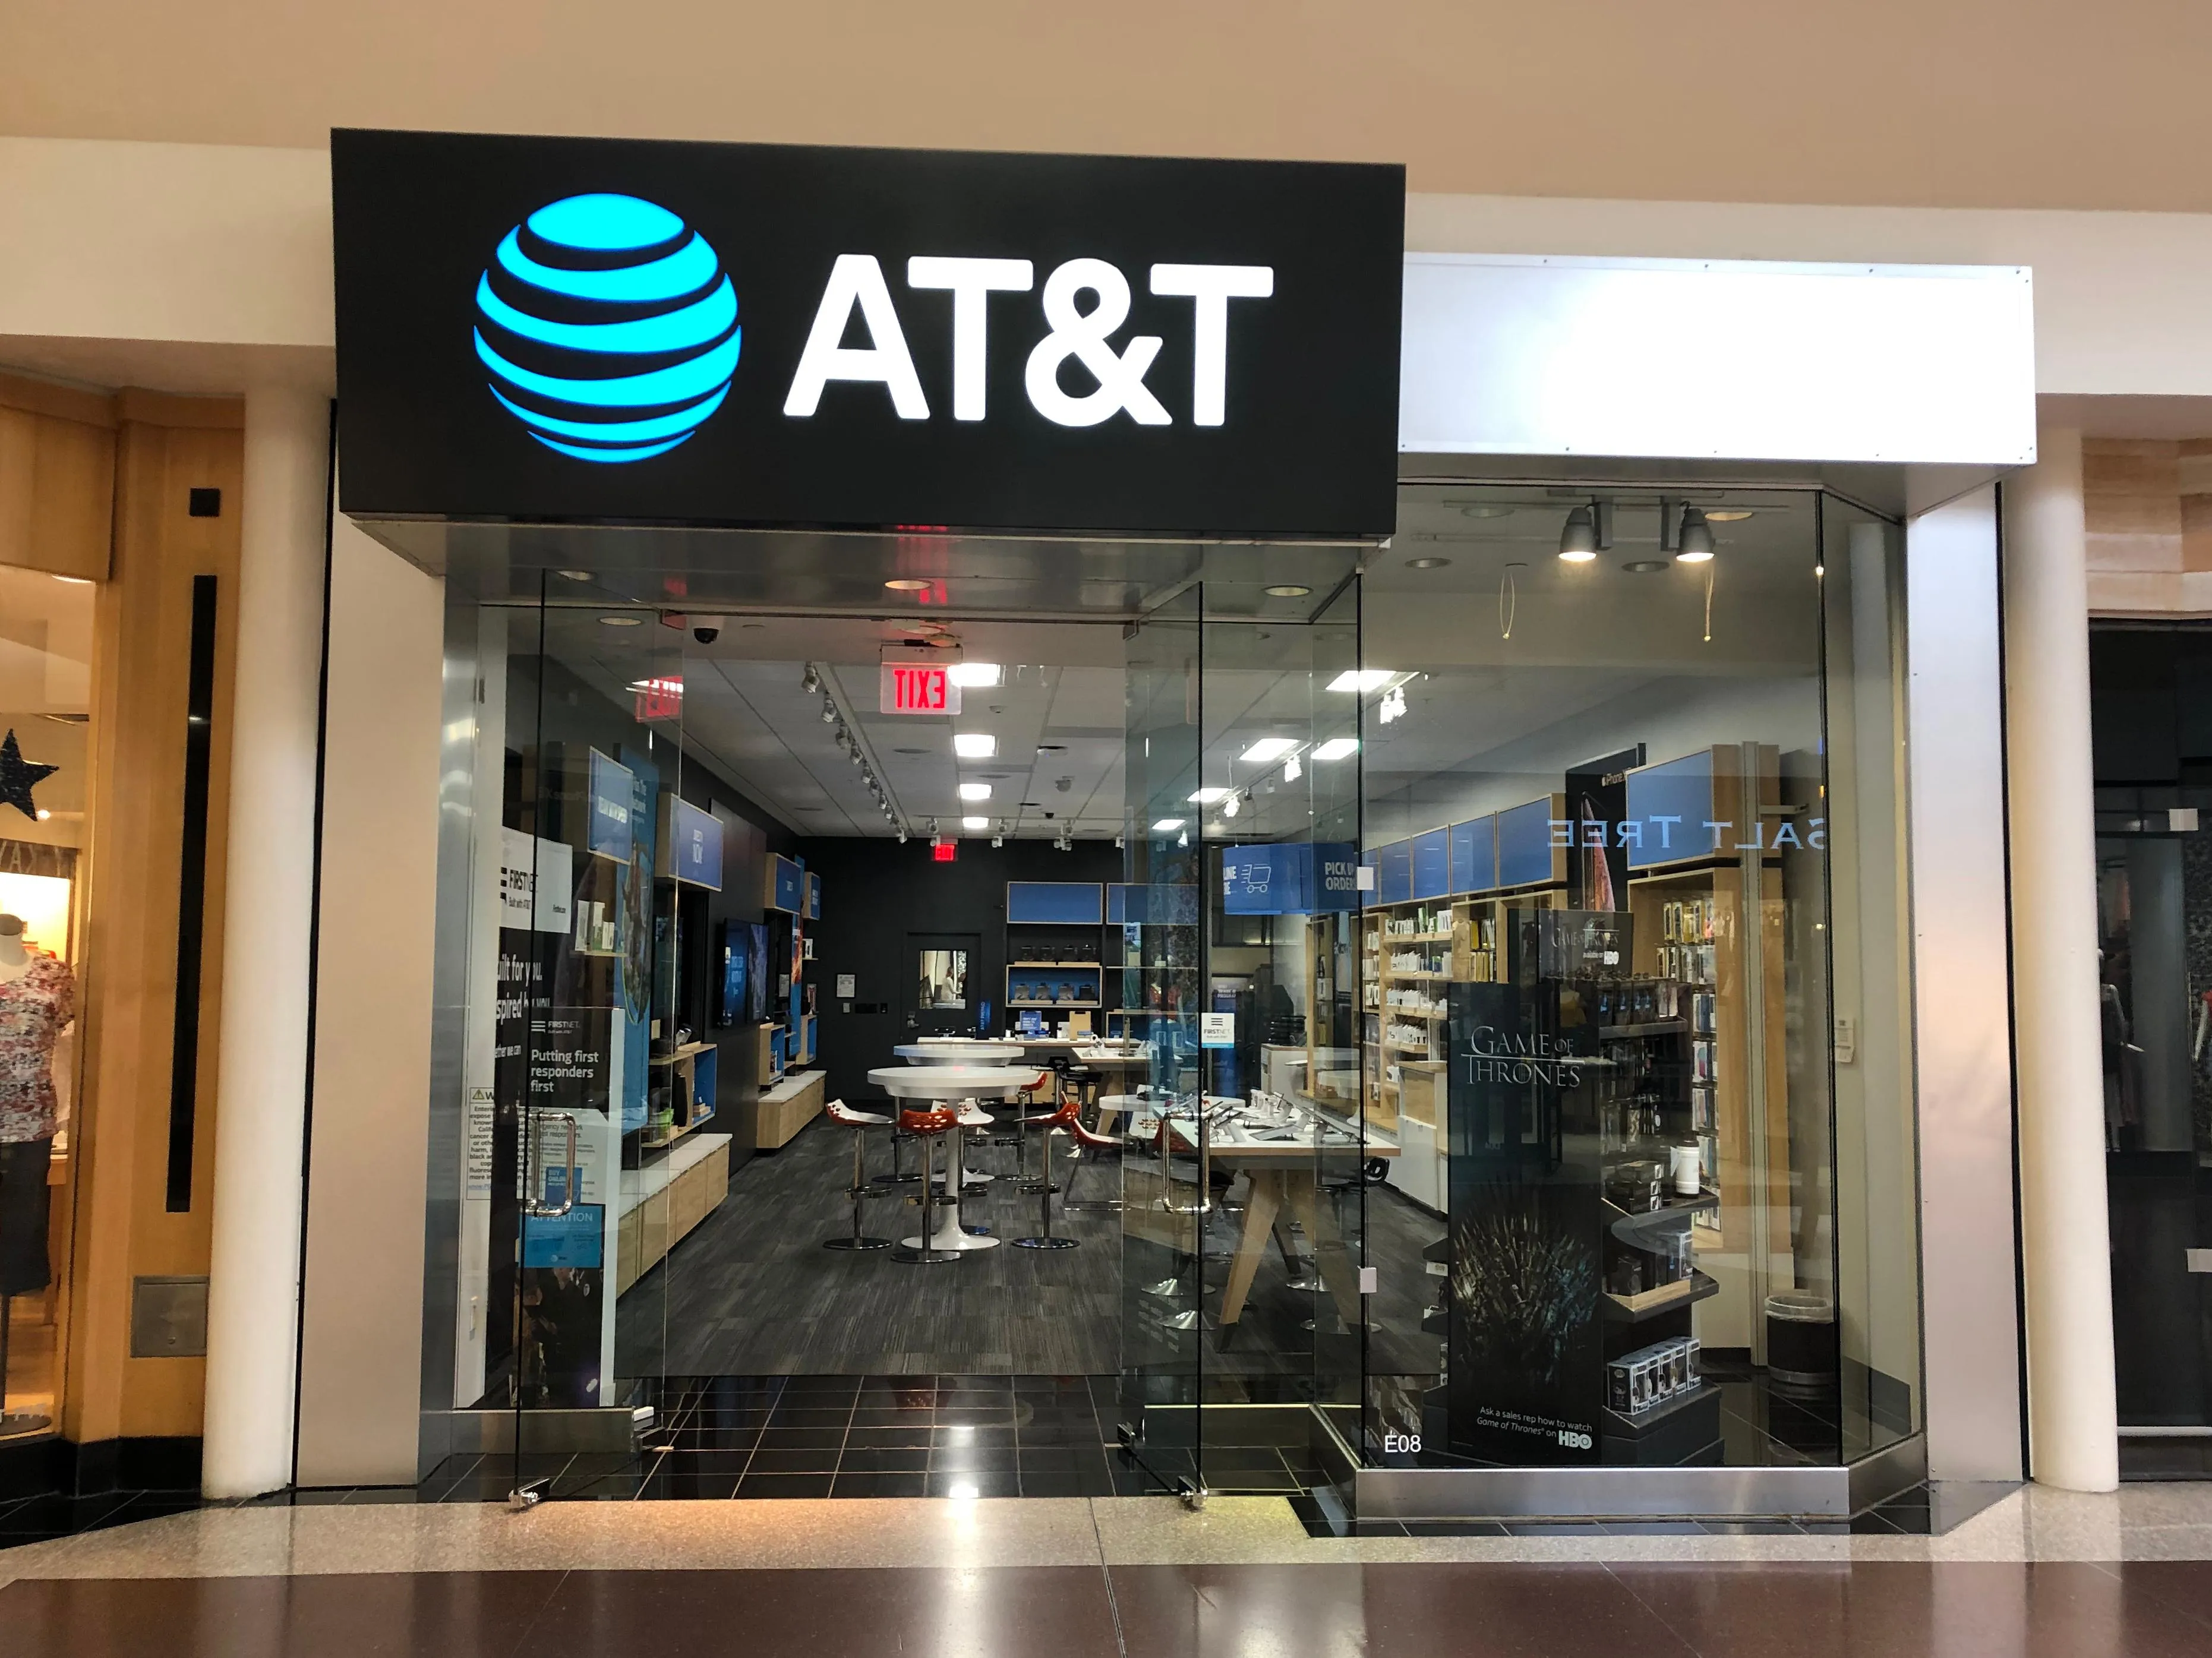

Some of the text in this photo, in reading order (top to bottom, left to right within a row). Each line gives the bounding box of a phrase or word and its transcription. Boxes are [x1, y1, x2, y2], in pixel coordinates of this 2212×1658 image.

[783, 254, 1274, 427] AT&T
[1324, 862, 1346, 875] PICK
[497, 953, 510, 981] uilt
[512, 954, 523, 981] for
[1604, 950, 1619, 965] HBO
[496, 991, 522, 1025] spired
[1471, 1025, 1574, 1056] GAME OF
[531, 1049, 599, 1065] Putting first
[531, 1066, 594, 1079] responders
[1466, 1054, 1580, 1088] THRONES
[531, 1080, 554, 1092] first
[531, 1212, 593, 1222] ATTENTION
[1480, 1407, 1494, 1416] Ask
[1502, 1411, 1521, 1420] sales
[1523, 1415, 1536, 1424] rep
[1538, 1416, 1555, 1426] how
[1557, 1419, 1566, 1428] to
[1567, 1422, 1592, 1432] watch
[1477, 1417, 1499, 1428] Game
[1501, 1421, 1510, 1430] of
[1546, 1429, 1557, 1438] on
[1558, 1429, 1592, 1449] HBO
[1384, 1435, 1422, 1453] E08
